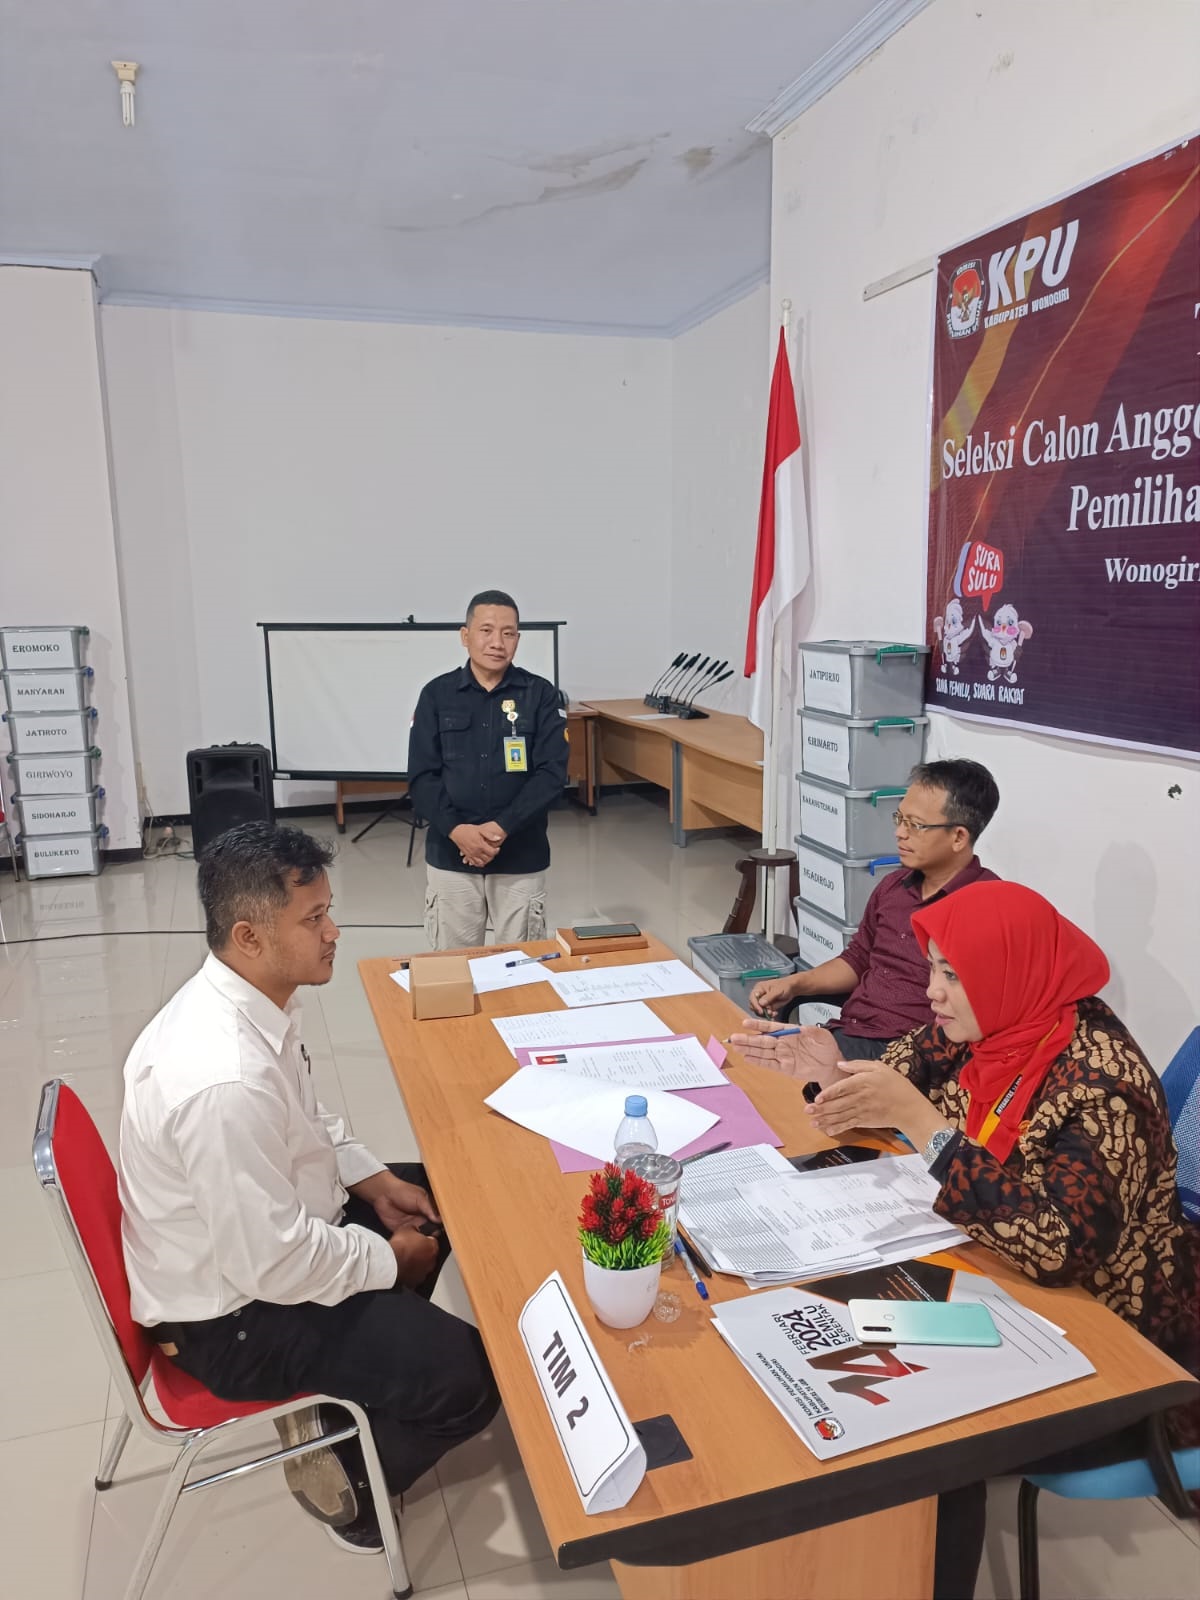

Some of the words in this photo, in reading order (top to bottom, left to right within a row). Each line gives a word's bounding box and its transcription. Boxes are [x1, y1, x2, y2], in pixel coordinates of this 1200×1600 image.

[987, 219, 1079, 311] KPU
[984, 304, 1029, 329] KABUPATEN
[1031, 288, 1070, 312] WONOGIRI
[943, 425, 1016, 480] Seleksi
[1022, 415, 1100, 466] Calon
[974, 544, 1001, 571] SURA
[967, 566, 997, 592] SULU
[1104, 555, 1200, 589] Wonogir
[12, 644, 60, 653] EROMOKO
[17, 688, 65, 696] MANYARAN
[973, 682, 995, 701] SUARA
[25, 729, 67, 737] JATIROTO
[25, 769, 73, 779] GIRIWOYO
[31, 811, 77, 820] SIDOHARJO
[34, 849, 80, 858] BULUKERTO
[771, 1313, 811, 1355] FEBRUARI
[781, 1309, 832, 1351] 2024
[803, 1305, 846, 1346] PEMILU
[815, 1303, 855, 1343] SERENTAK
[756, 1352, 773, 1370] UMUM
[770, 1358, 796, 1384] WONOGIRI
[542, 1330, 577, 1399] TIM
[566, 1395, 589, 1431] 2
[770, 1368, 797, 1397] PEMILIHAN
[793, 1383, 822, 1414] KABUPATEN
[794, 1396, 814, 1416] KOMISI
